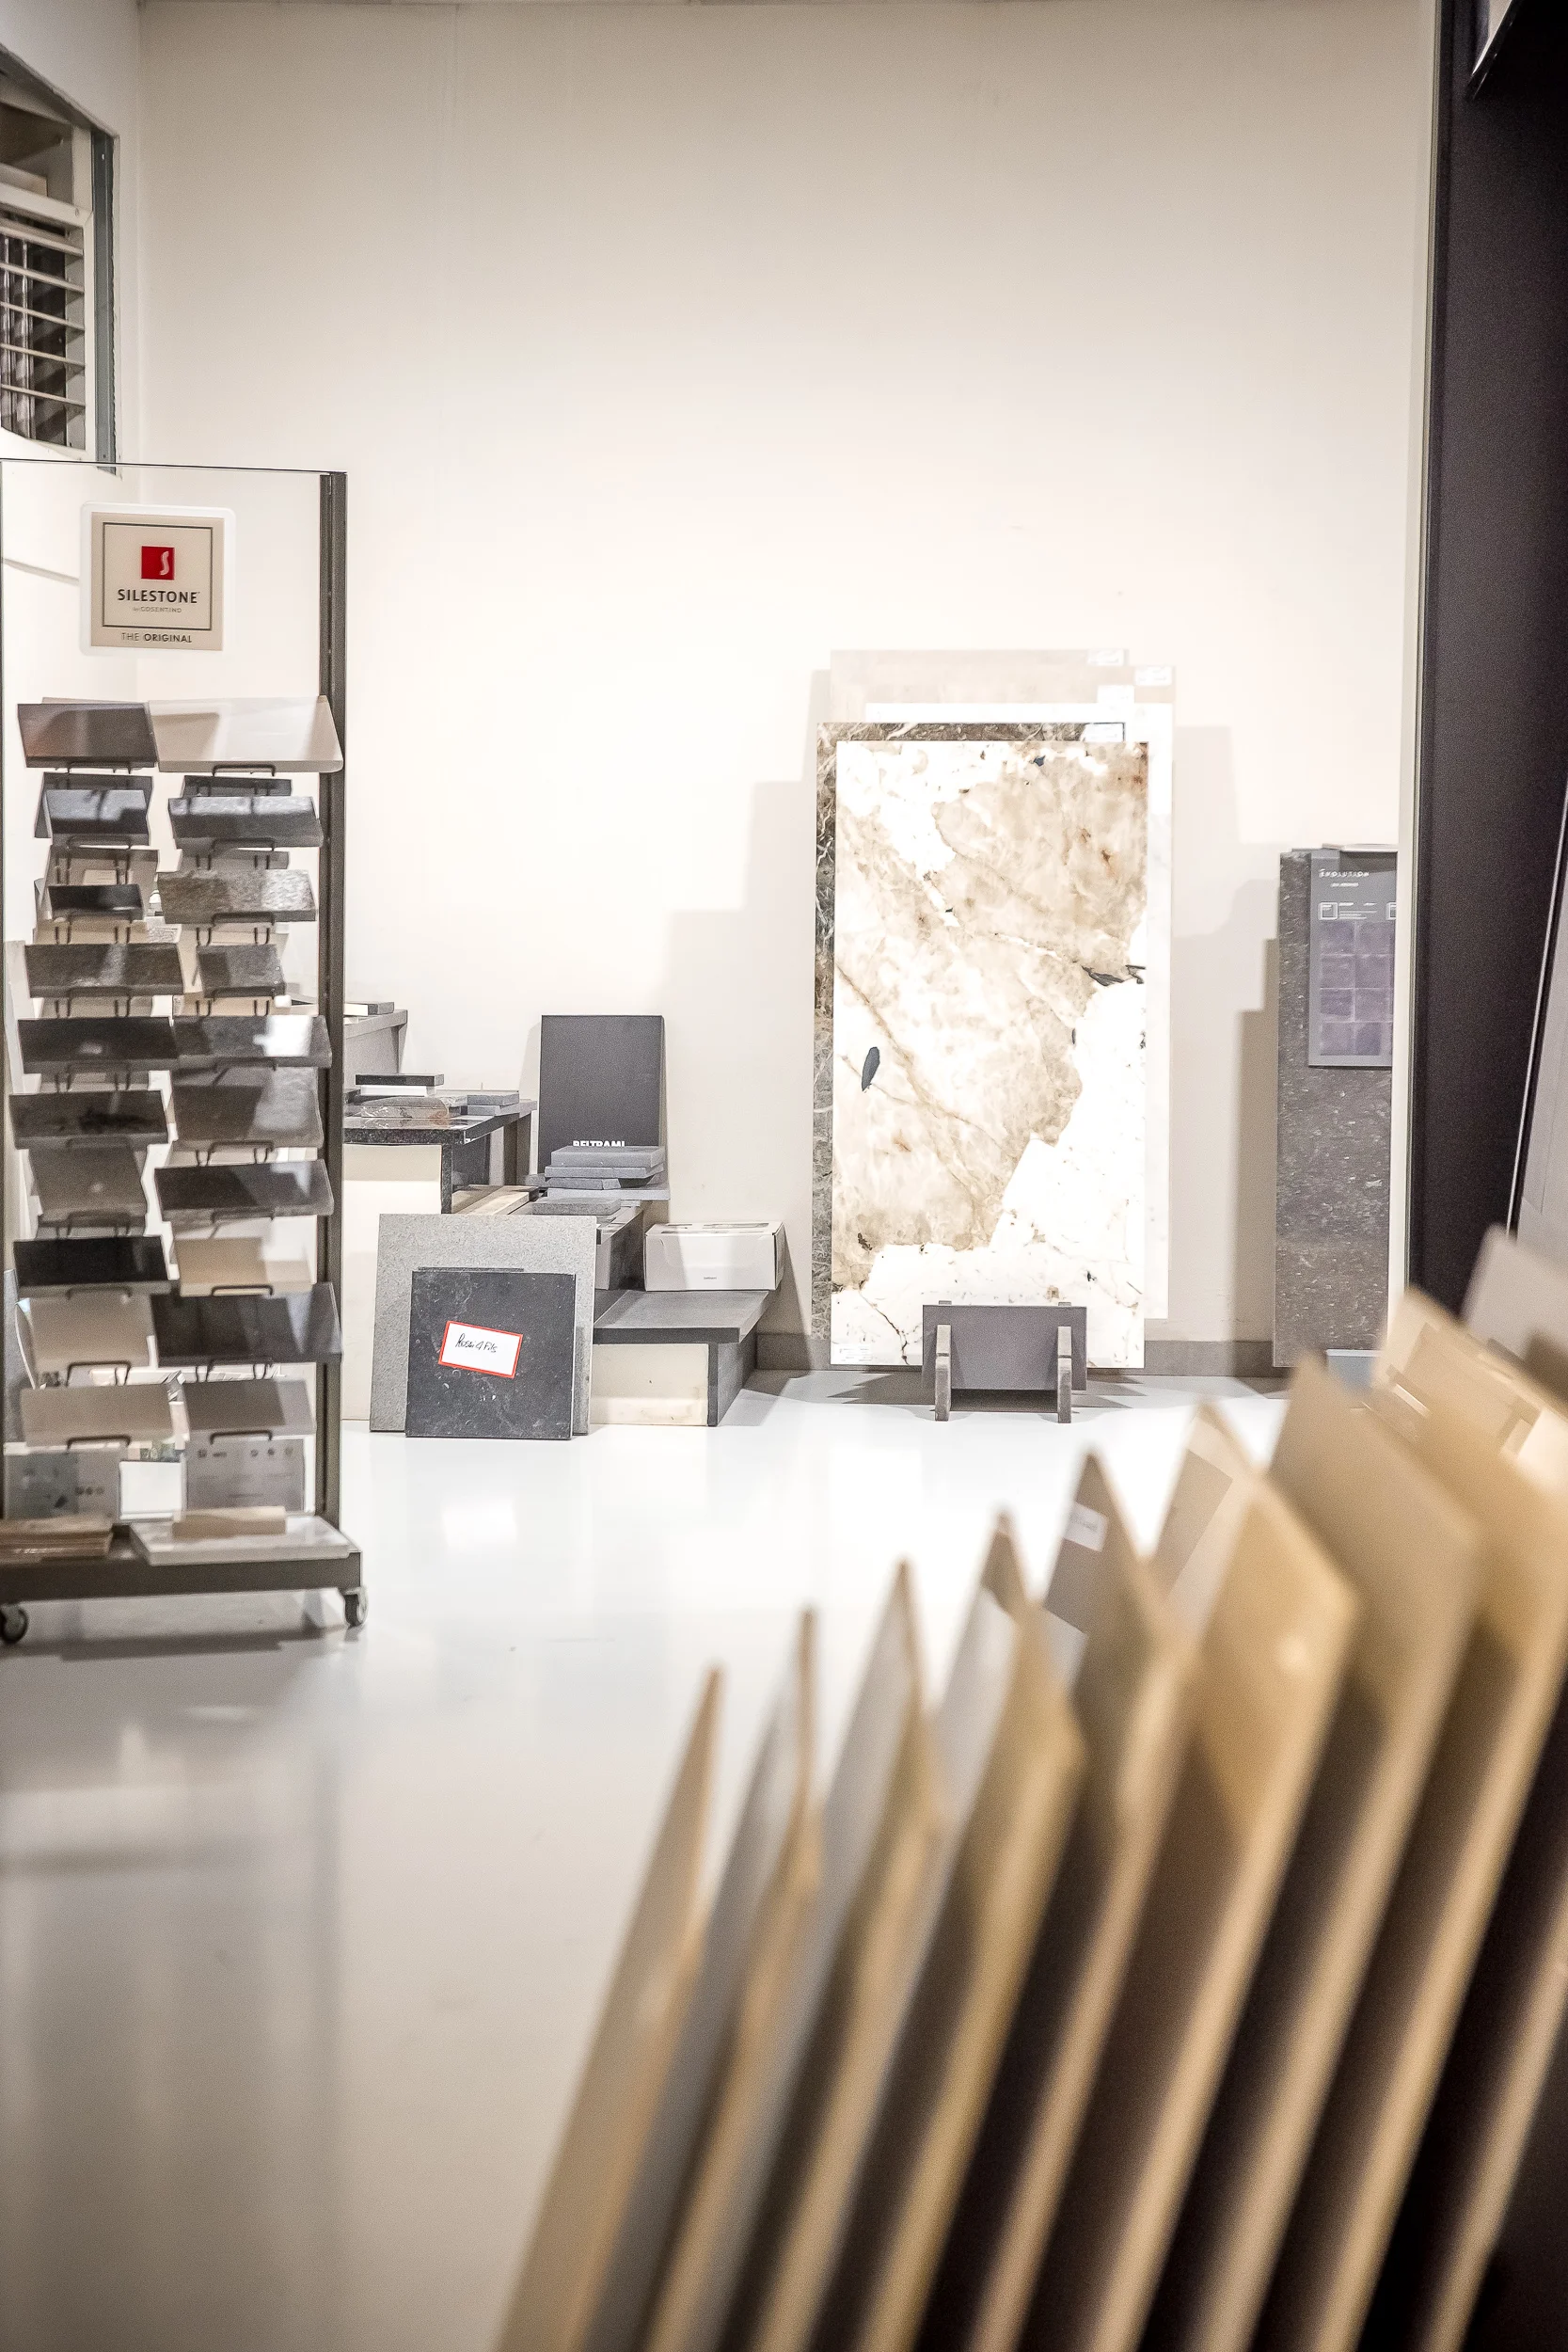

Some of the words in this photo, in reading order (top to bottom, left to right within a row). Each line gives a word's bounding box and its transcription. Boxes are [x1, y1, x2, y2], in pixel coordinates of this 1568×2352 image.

[118, 589, 198, 603] SILESTONE
[121, 632, 140, 642] THE
[144, 633, 192, 644] ORIGINAL
